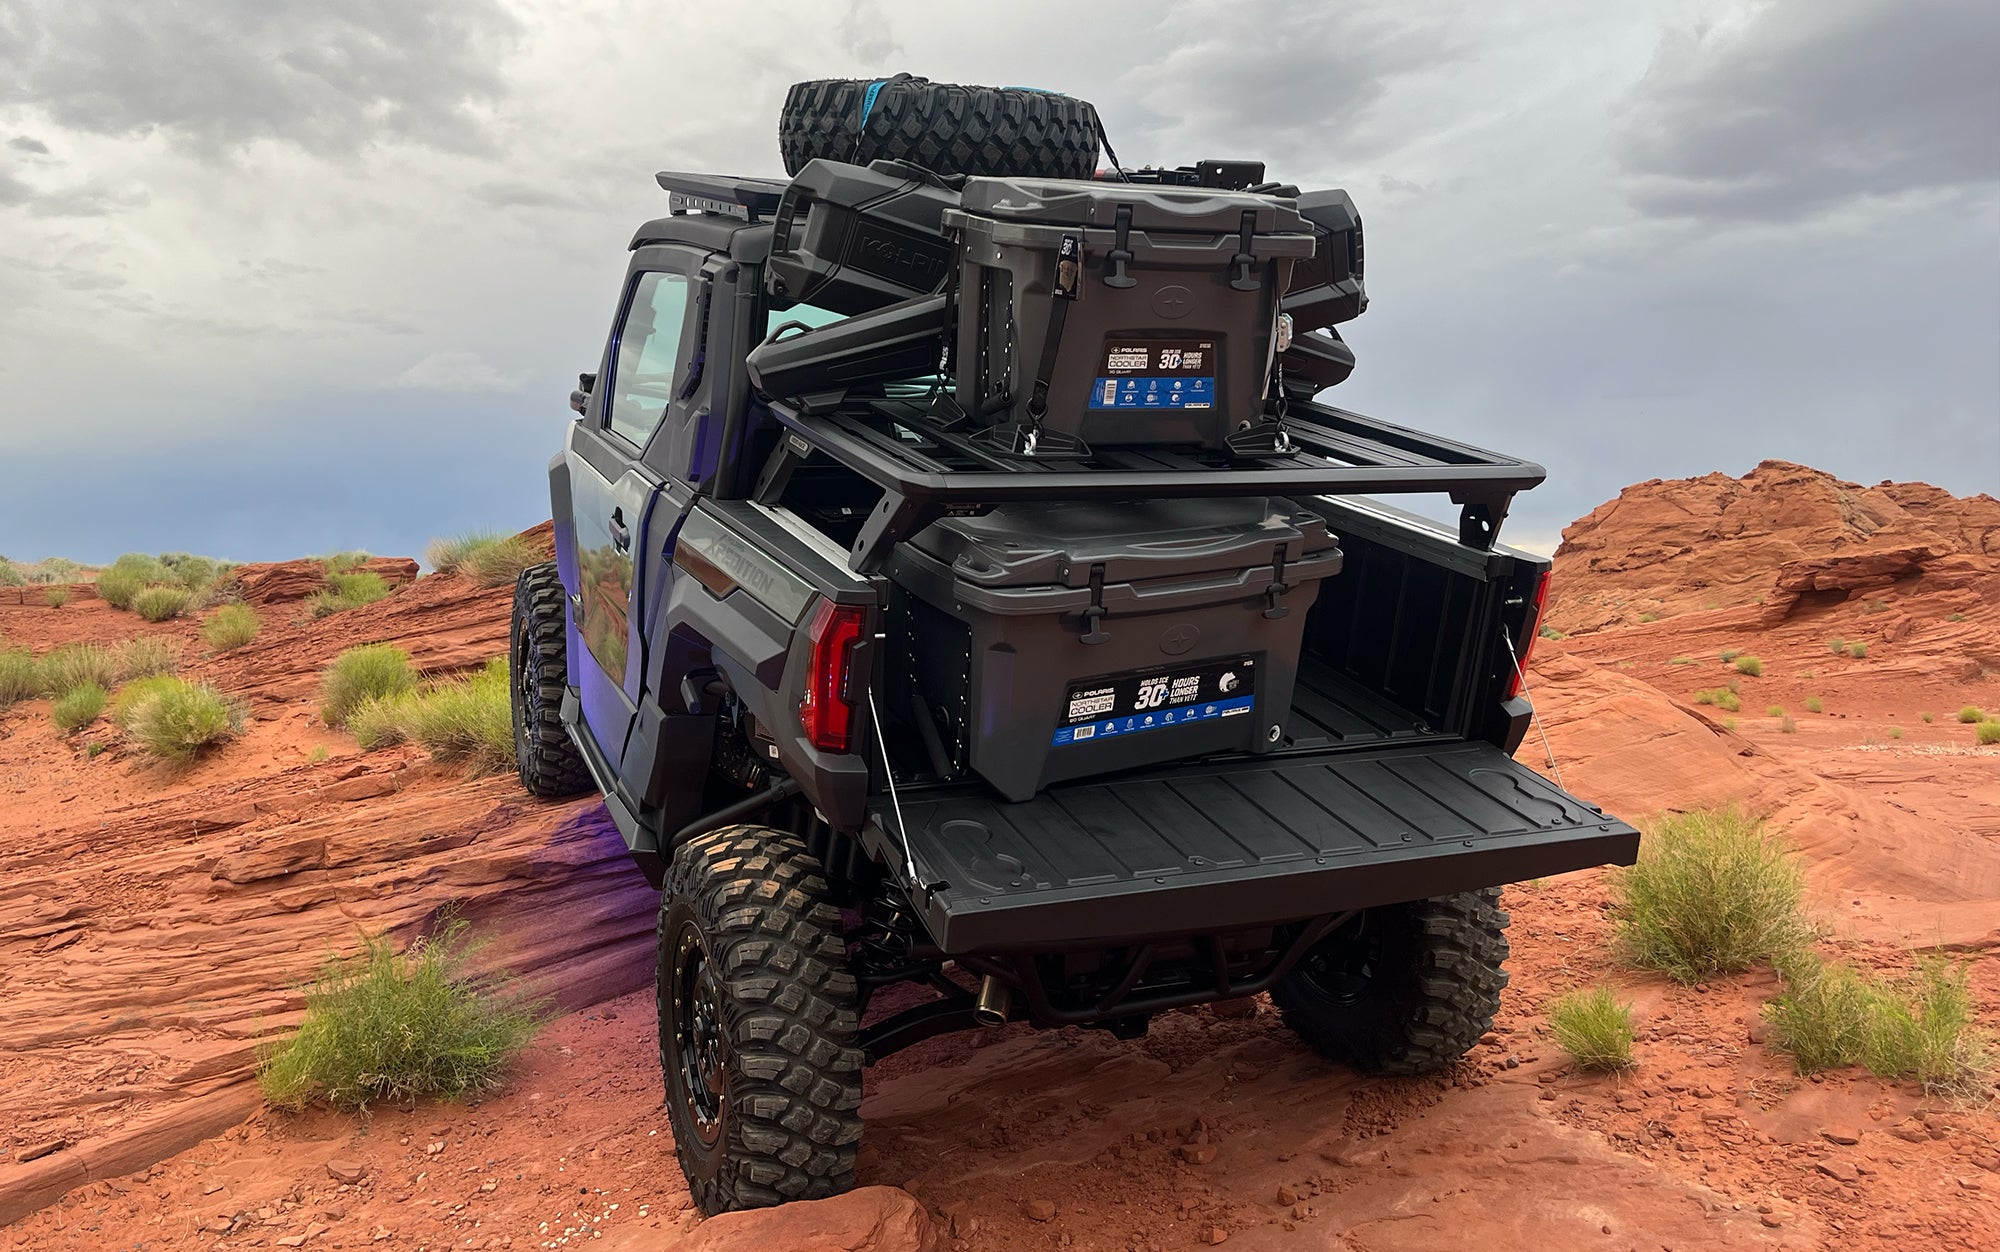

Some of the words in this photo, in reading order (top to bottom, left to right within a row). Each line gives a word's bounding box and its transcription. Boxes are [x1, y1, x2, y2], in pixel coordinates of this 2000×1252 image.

[702, 533, 775, 595] XPEDITION
[1140, 678, 1159, 687] HOLDS
[1158, 676, 1169, 684] ICE
[1171, 675, 1200, 689] HOURS
[1084, 687, 1114, 697] POLARIS
[1170, 685, 1199, 698] LONGER
[1071, 697, 1114, 707] NORTHSTAR
[1169, 696, 1184, 705] THAN
[1071, 702, 1112, 715] COOLER
